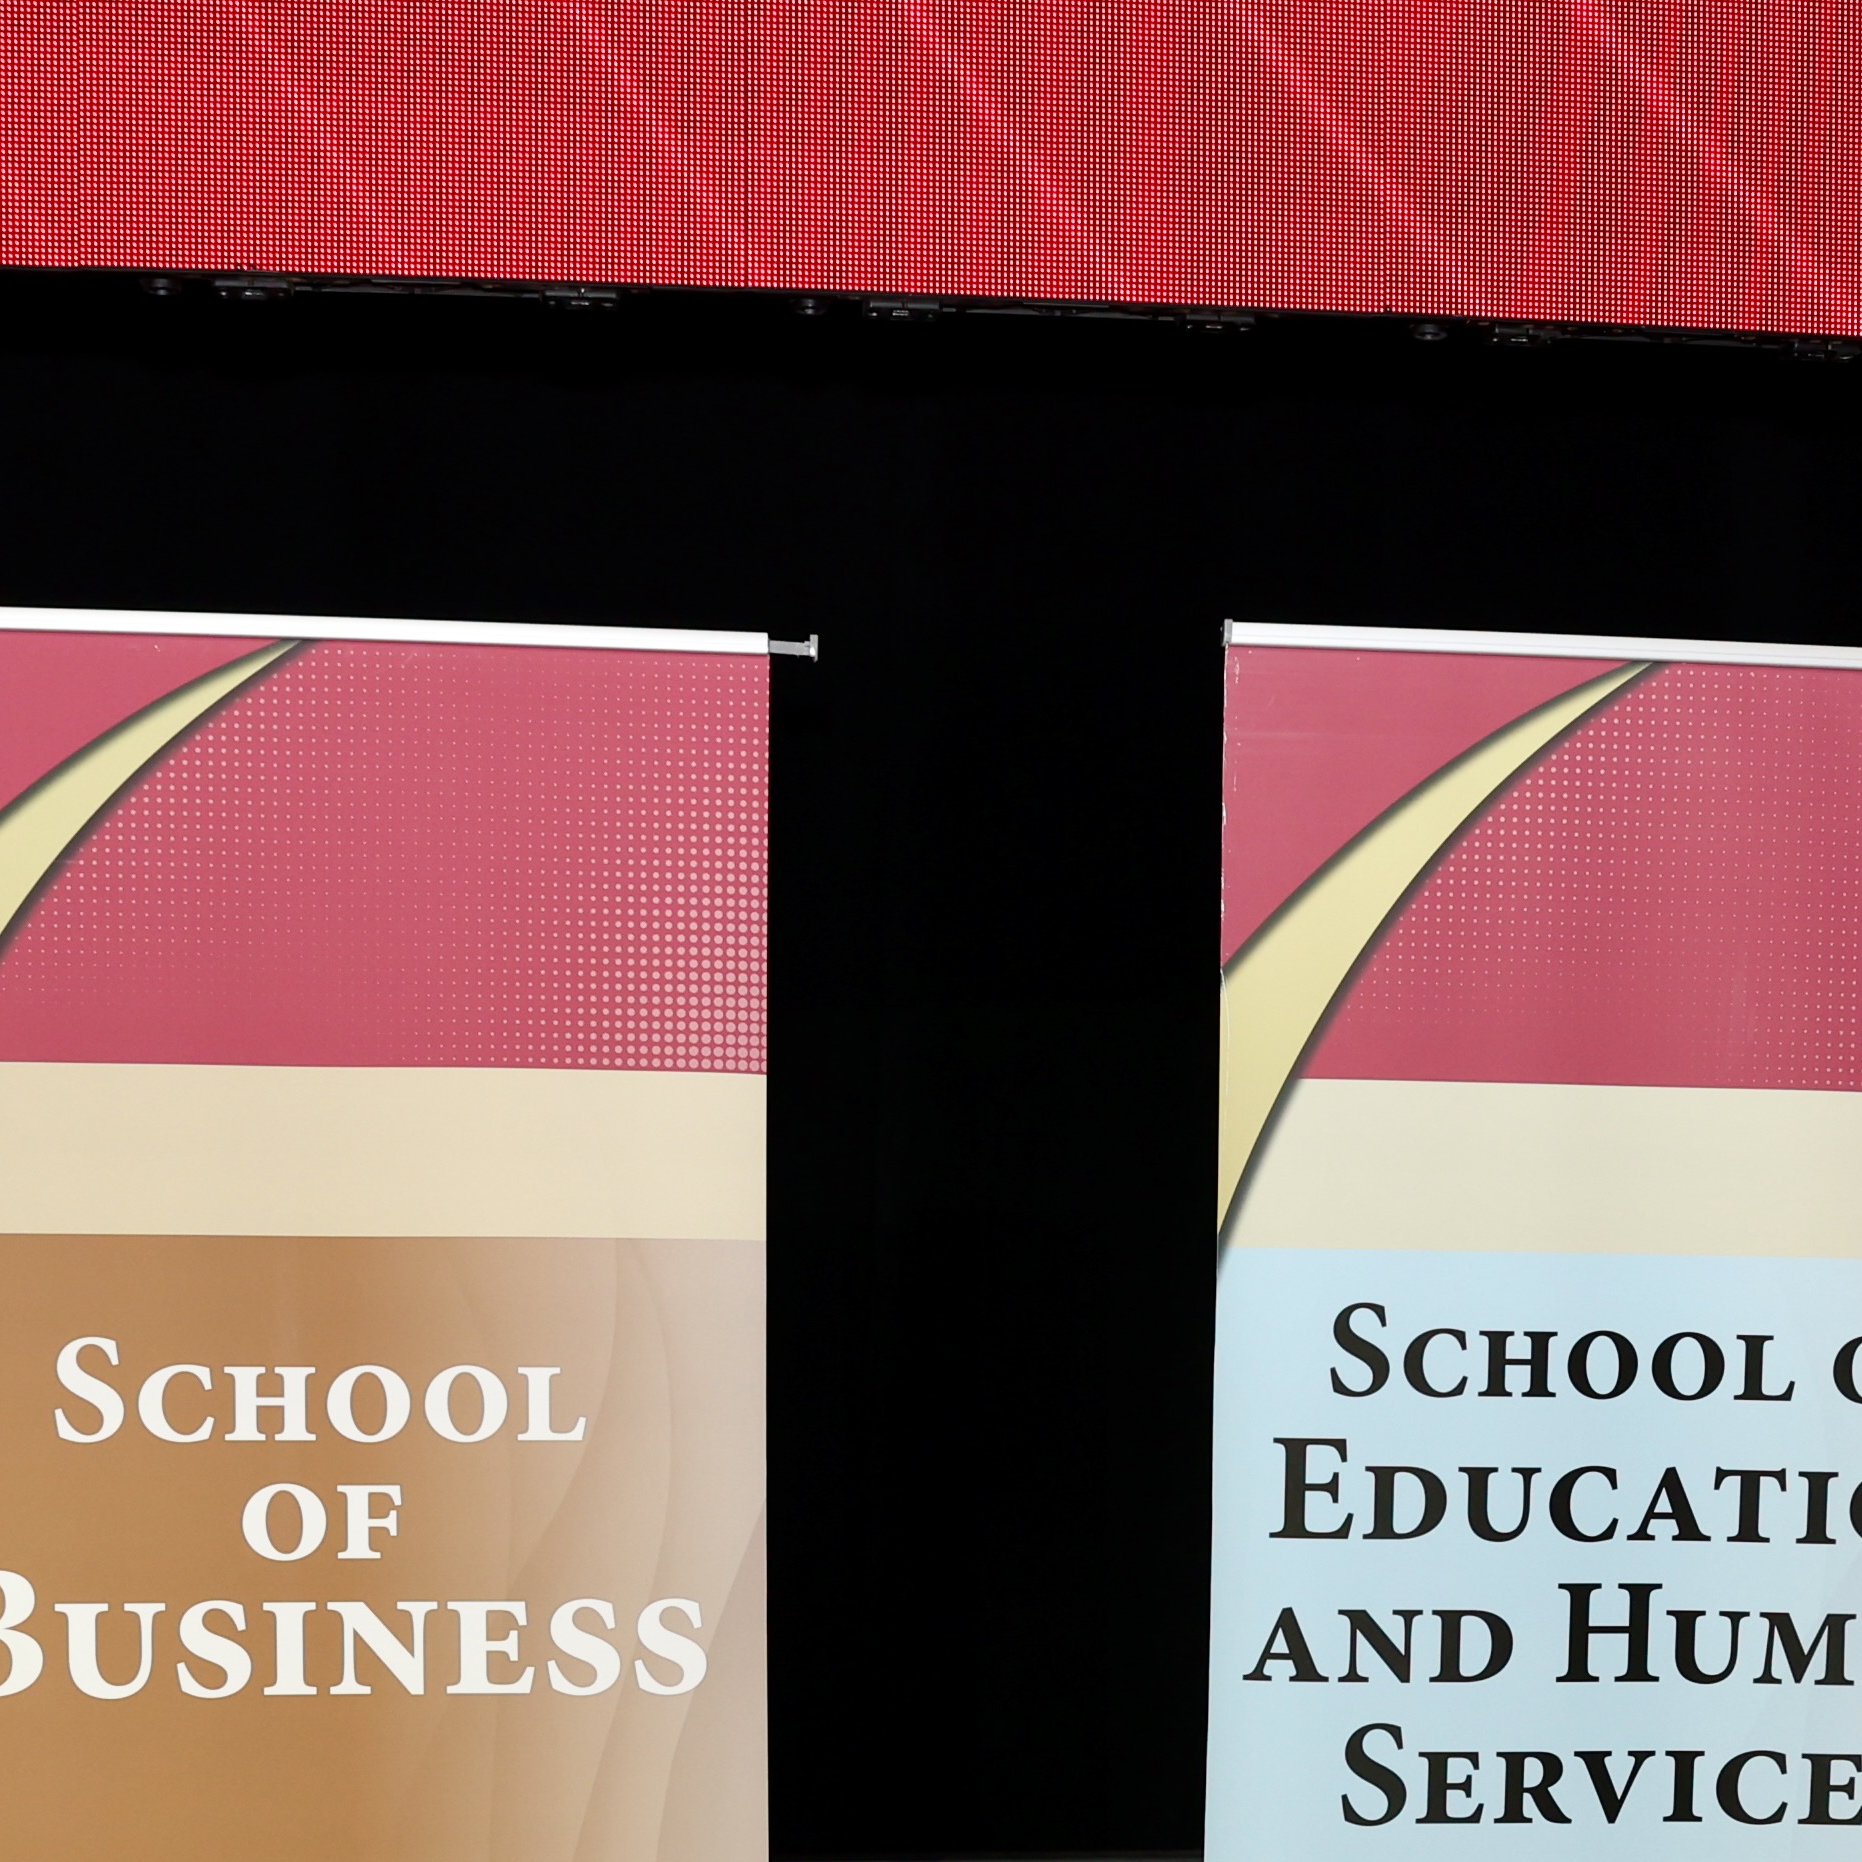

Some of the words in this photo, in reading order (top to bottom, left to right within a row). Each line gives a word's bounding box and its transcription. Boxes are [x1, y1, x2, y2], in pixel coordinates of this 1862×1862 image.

[54, 1336, 587, 1443] SCHOOL
[1330, 1302, 1796, 1402] SCHOOL
[242, 1483, 402, 1561] OF
[1242, 1606, 1514, 1684] AND
